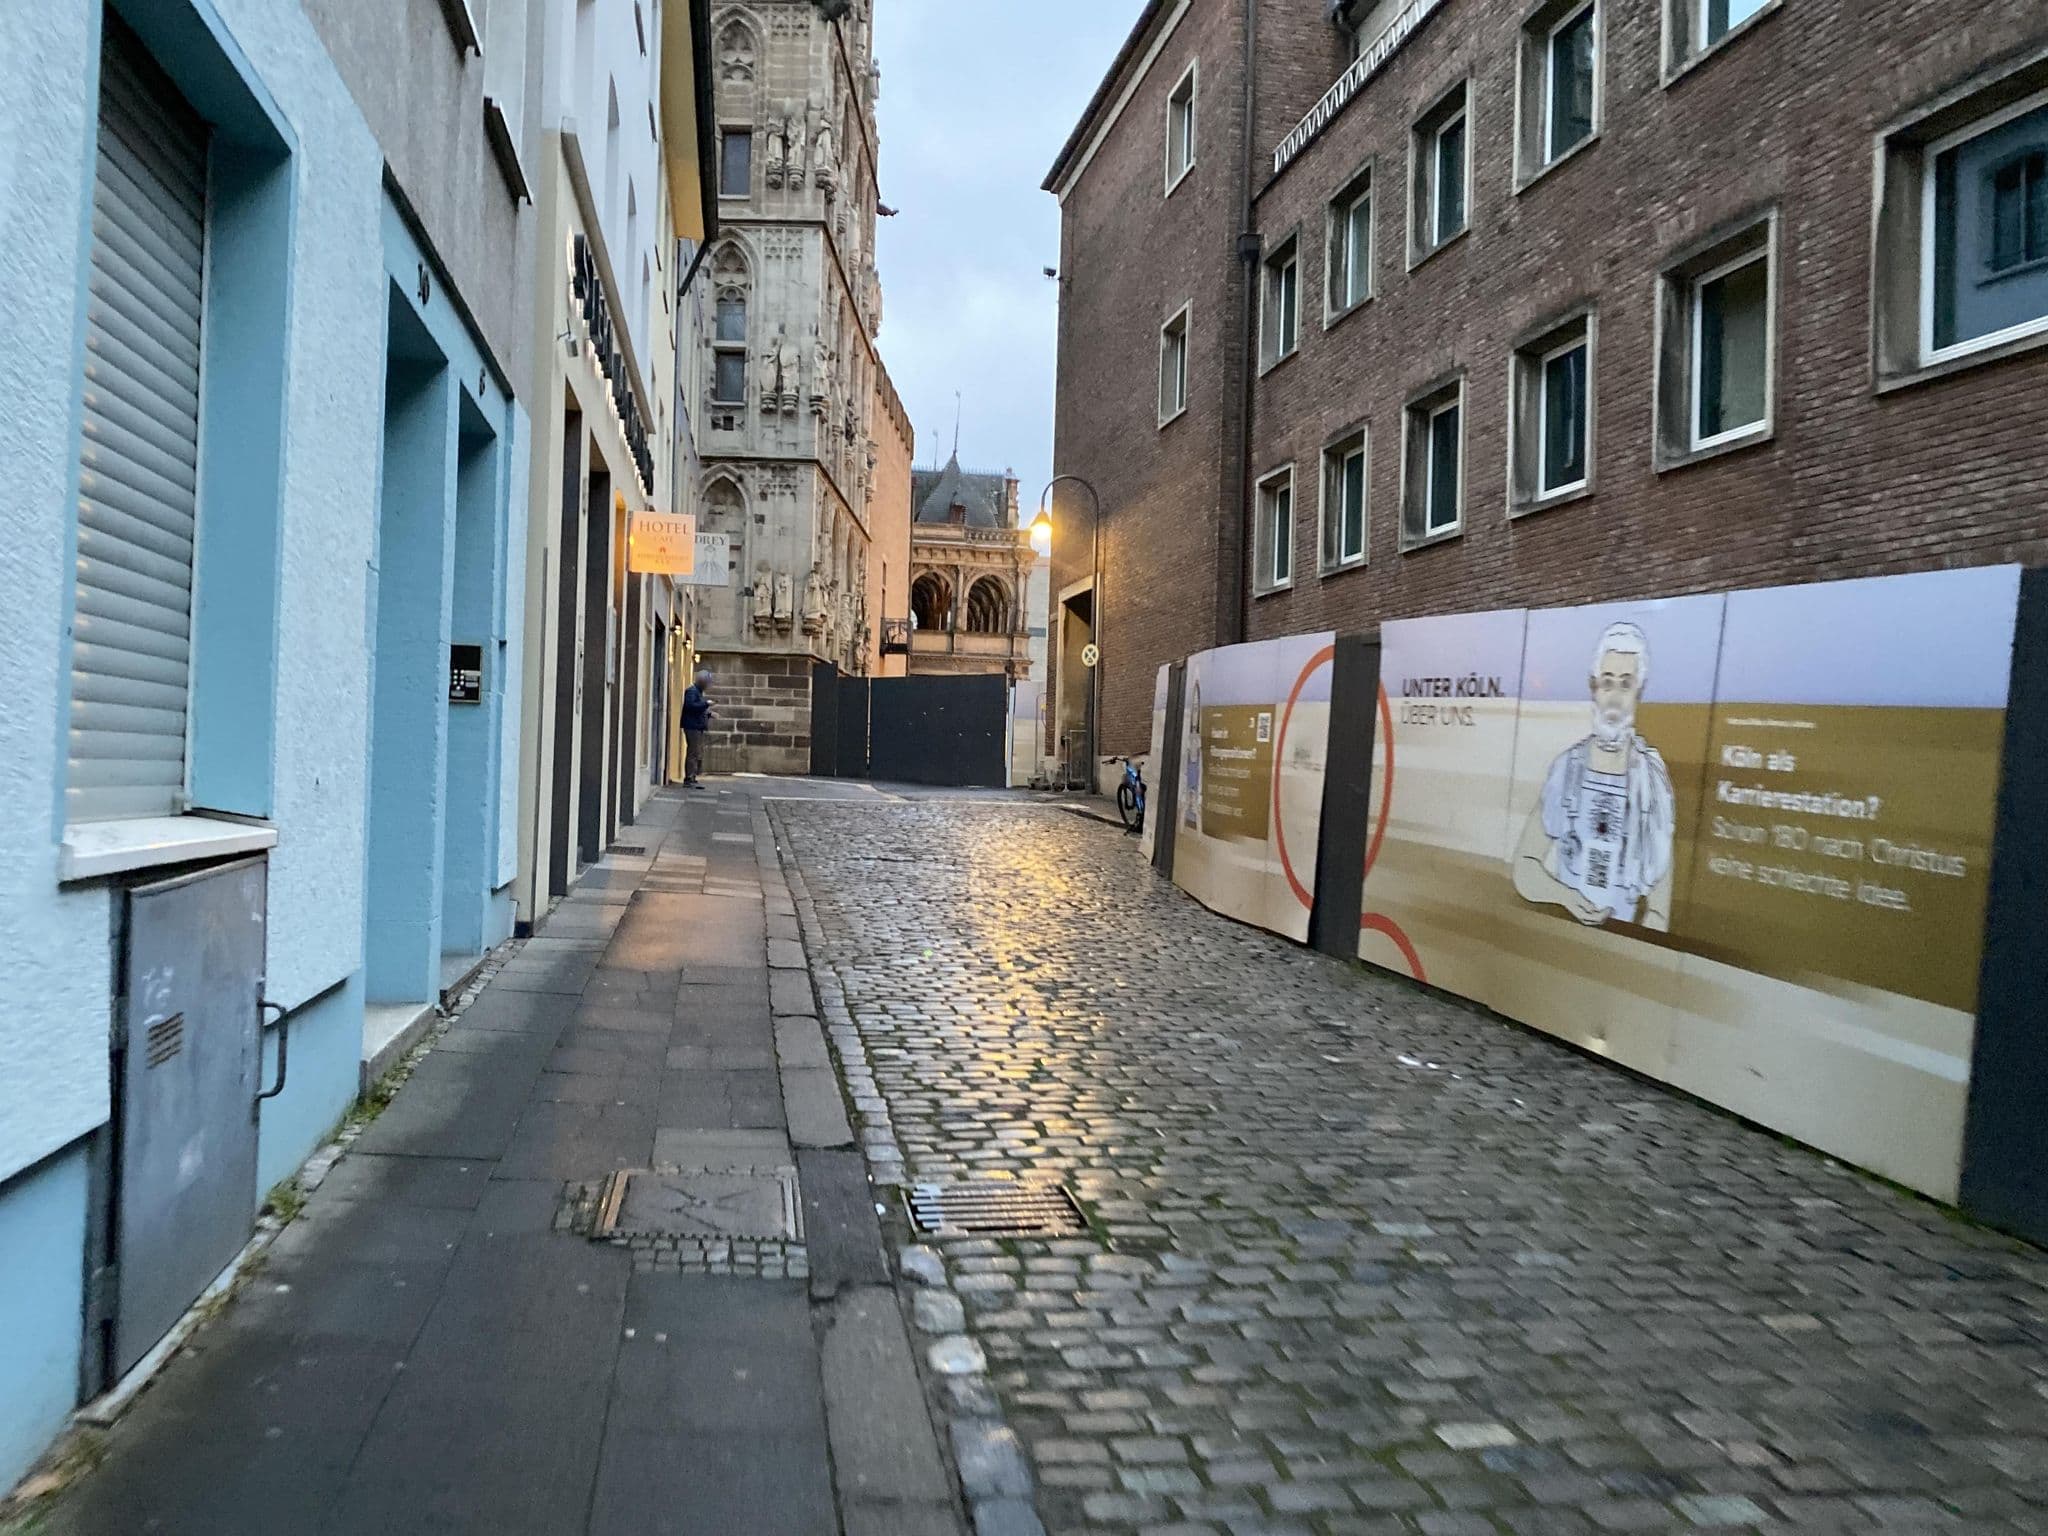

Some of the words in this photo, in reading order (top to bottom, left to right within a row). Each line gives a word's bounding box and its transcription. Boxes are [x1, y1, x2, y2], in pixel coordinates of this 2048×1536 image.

[640, 520, 687, 535] HOTEL
[1402, 677, 1451, 697] UNTER
[1456, 671, 1504, 697] KÖLN.
[1401, 700, 1437, 726] ÜBER
